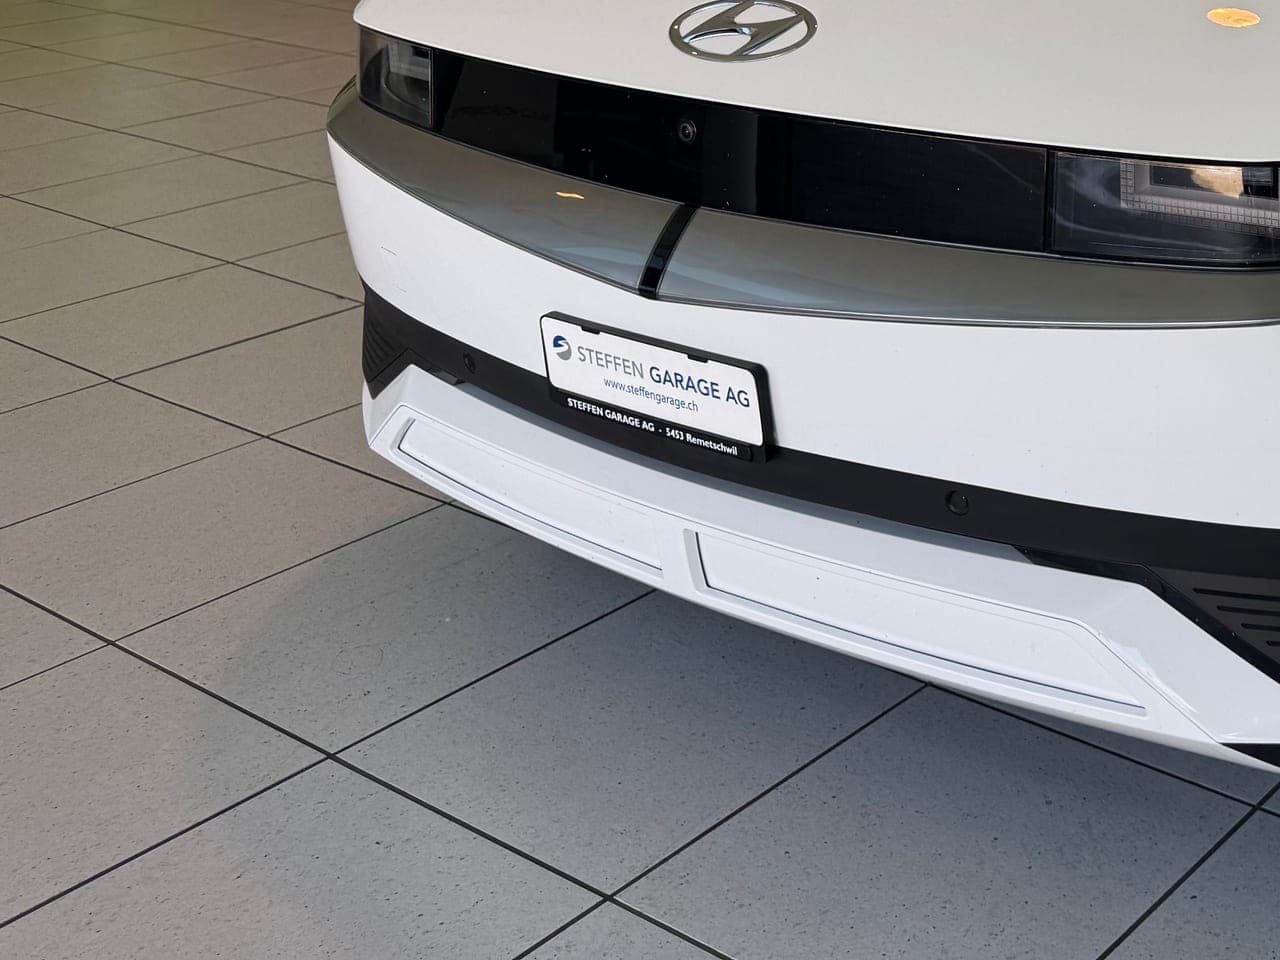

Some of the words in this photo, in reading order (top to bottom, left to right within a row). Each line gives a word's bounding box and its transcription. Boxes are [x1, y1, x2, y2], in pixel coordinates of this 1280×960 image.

[577, 345, 645, 379] STEFFEN
[649, 366, 721, 400] GARAGE
[725, 386, 751, 408] AG
[603, 377, 699, 413] www.steffengarage.ch
[567, 397, 604, 418] STEFFEN
[604, 407, 641, 428] GARAGE
[641, 418, 655, 432] AG
[665, 427, 684, 440] 5453
[686, 433, 738, 456] Remetschwil
